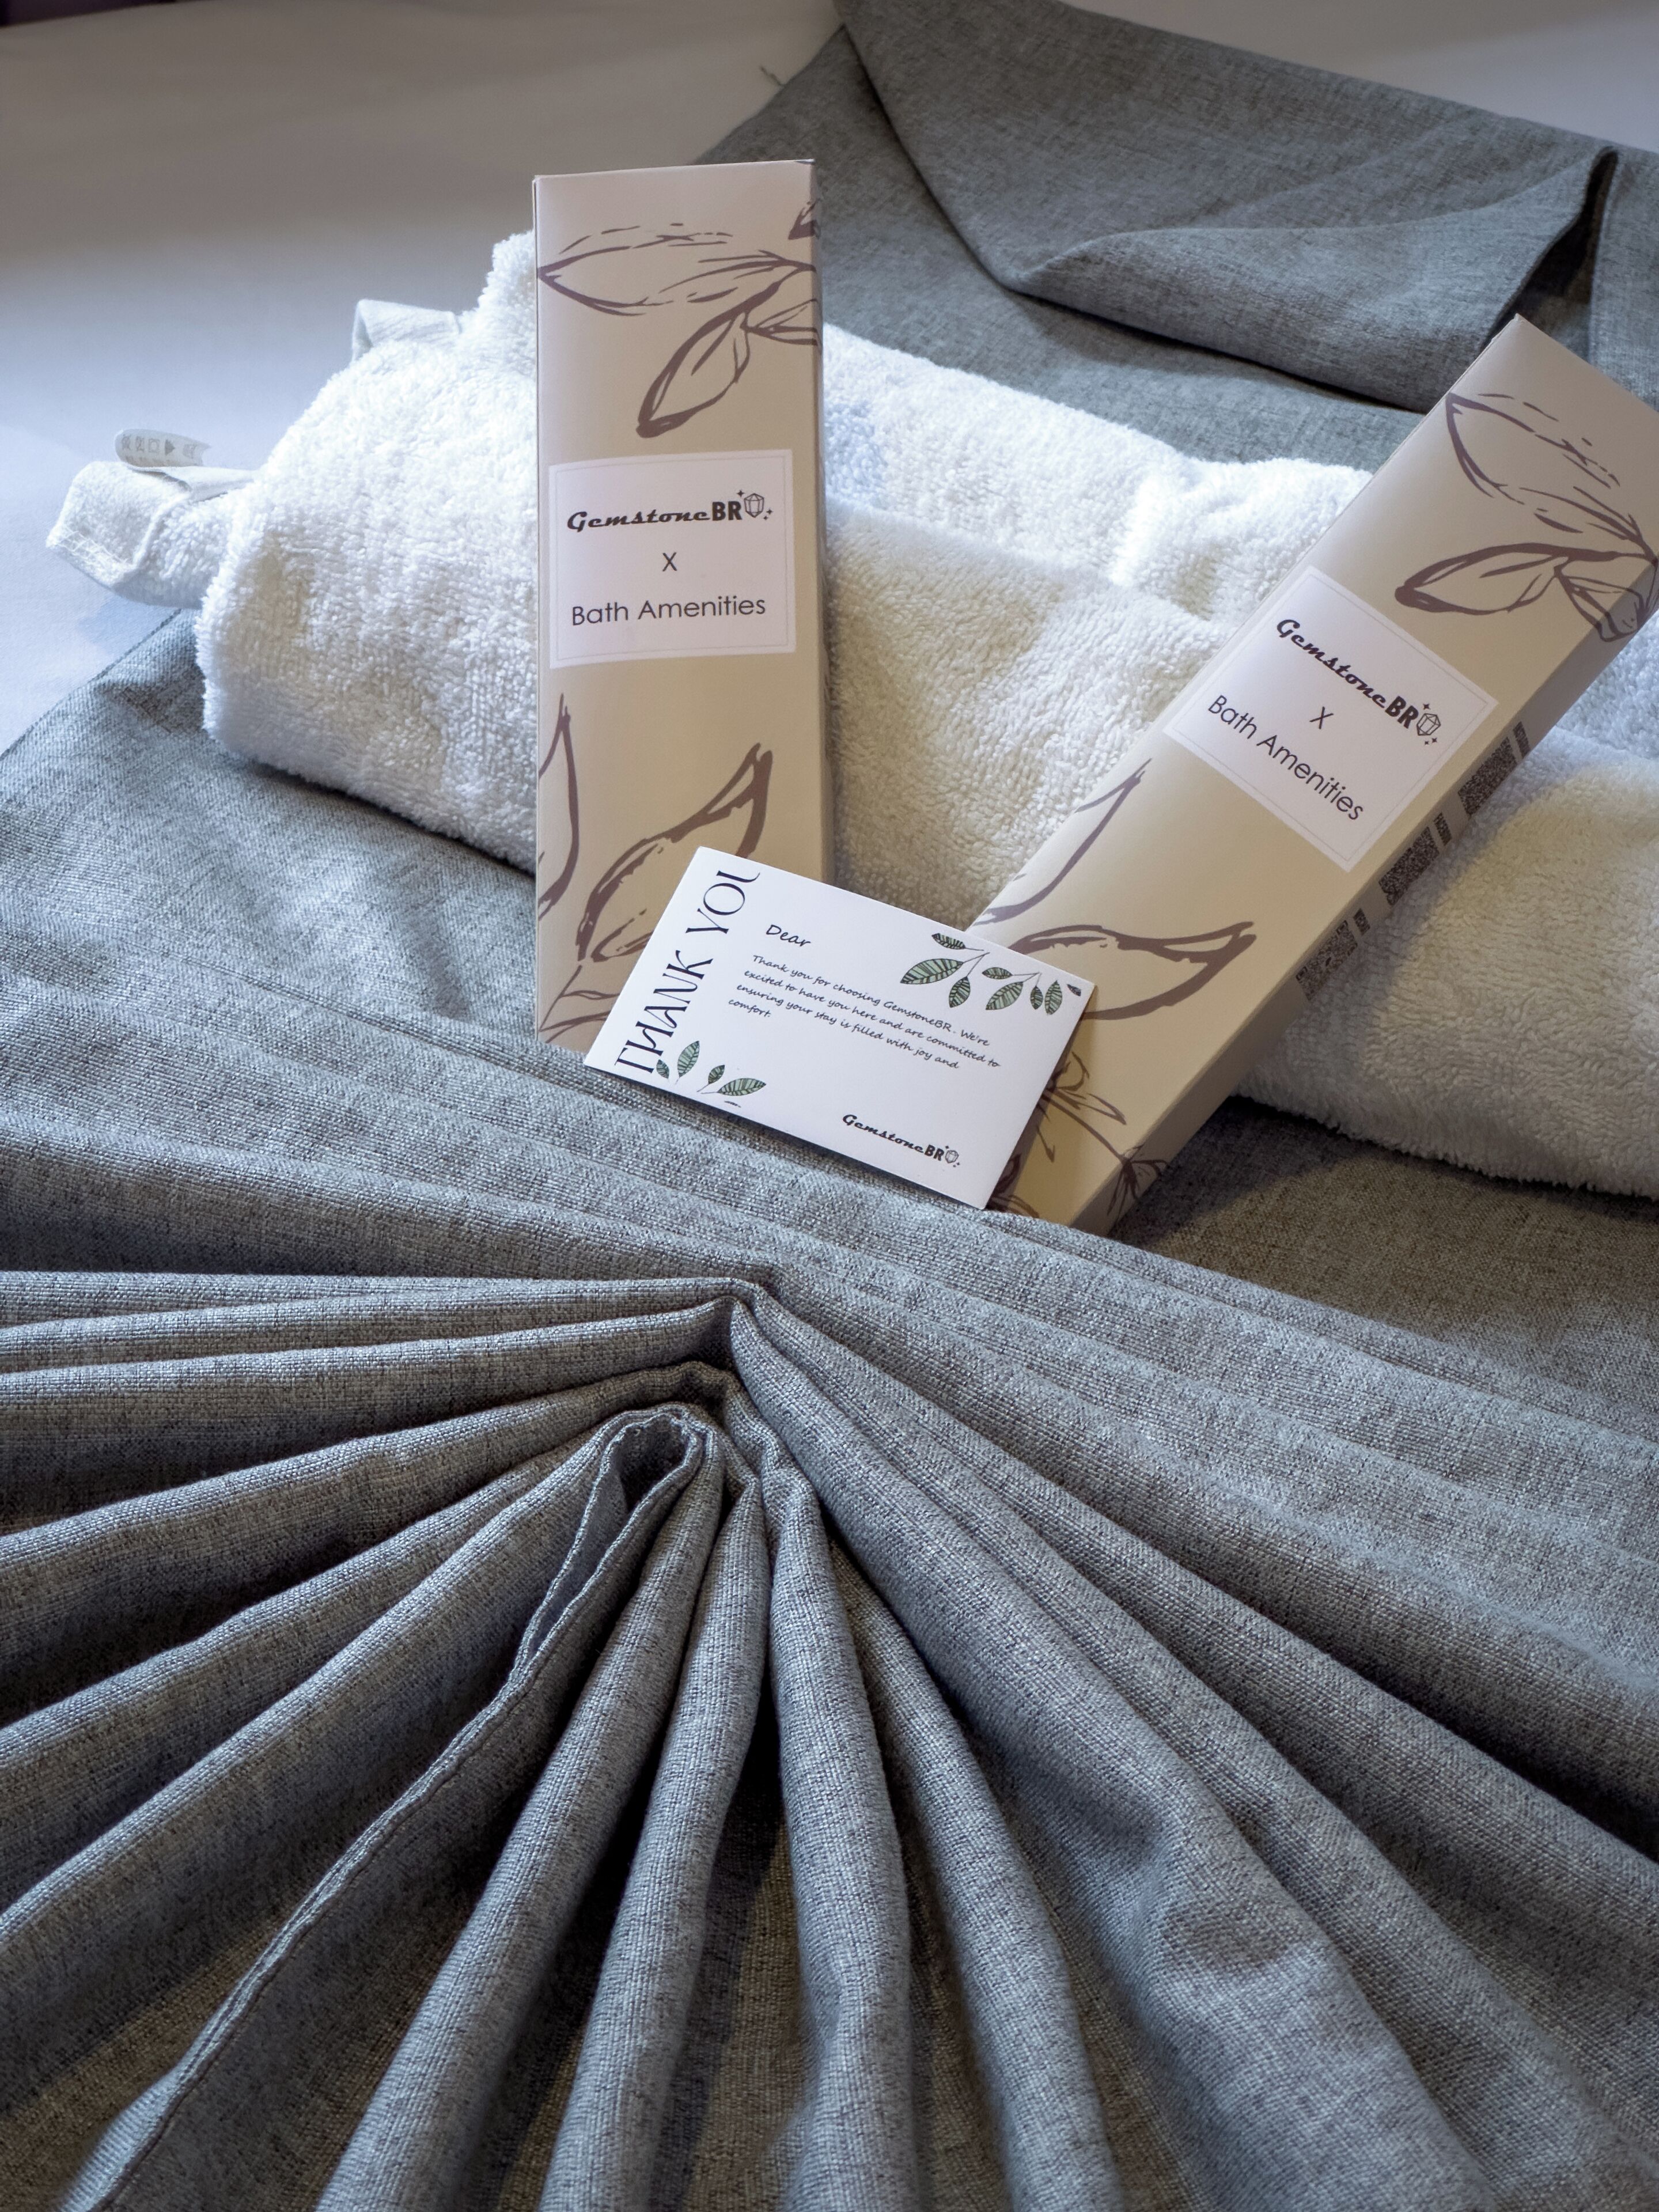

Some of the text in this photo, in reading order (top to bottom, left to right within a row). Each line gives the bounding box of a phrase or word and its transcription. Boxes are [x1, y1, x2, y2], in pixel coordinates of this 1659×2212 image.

[567, 501, 743, 532] GemstoneBR
[572, 595, 766, 626] Bath Amenities
[1277, 619, 1419, 729] GemstoneBR
[1207, 695, 1364, 821] Bath Amenities
[766, 924, 812, 947] Dear
[614, 950, 714, 1074] THANK
[728, 999, 771, 1018] comfort.
[736, 983, 960, 1069] ensuring your stay is filled with joy and
[744, 969, 1002, 1067] excited to have you here and are committed to
[753, 955, 790, 972] Thank
[790, 968, 813, 980] you
[812, 976, 831, 986] for
[832, 983, 881, 1007] choosing
[960, 1029, 991, 1047] We're
[842, 1114, 945, 1162] GemstoneBR
